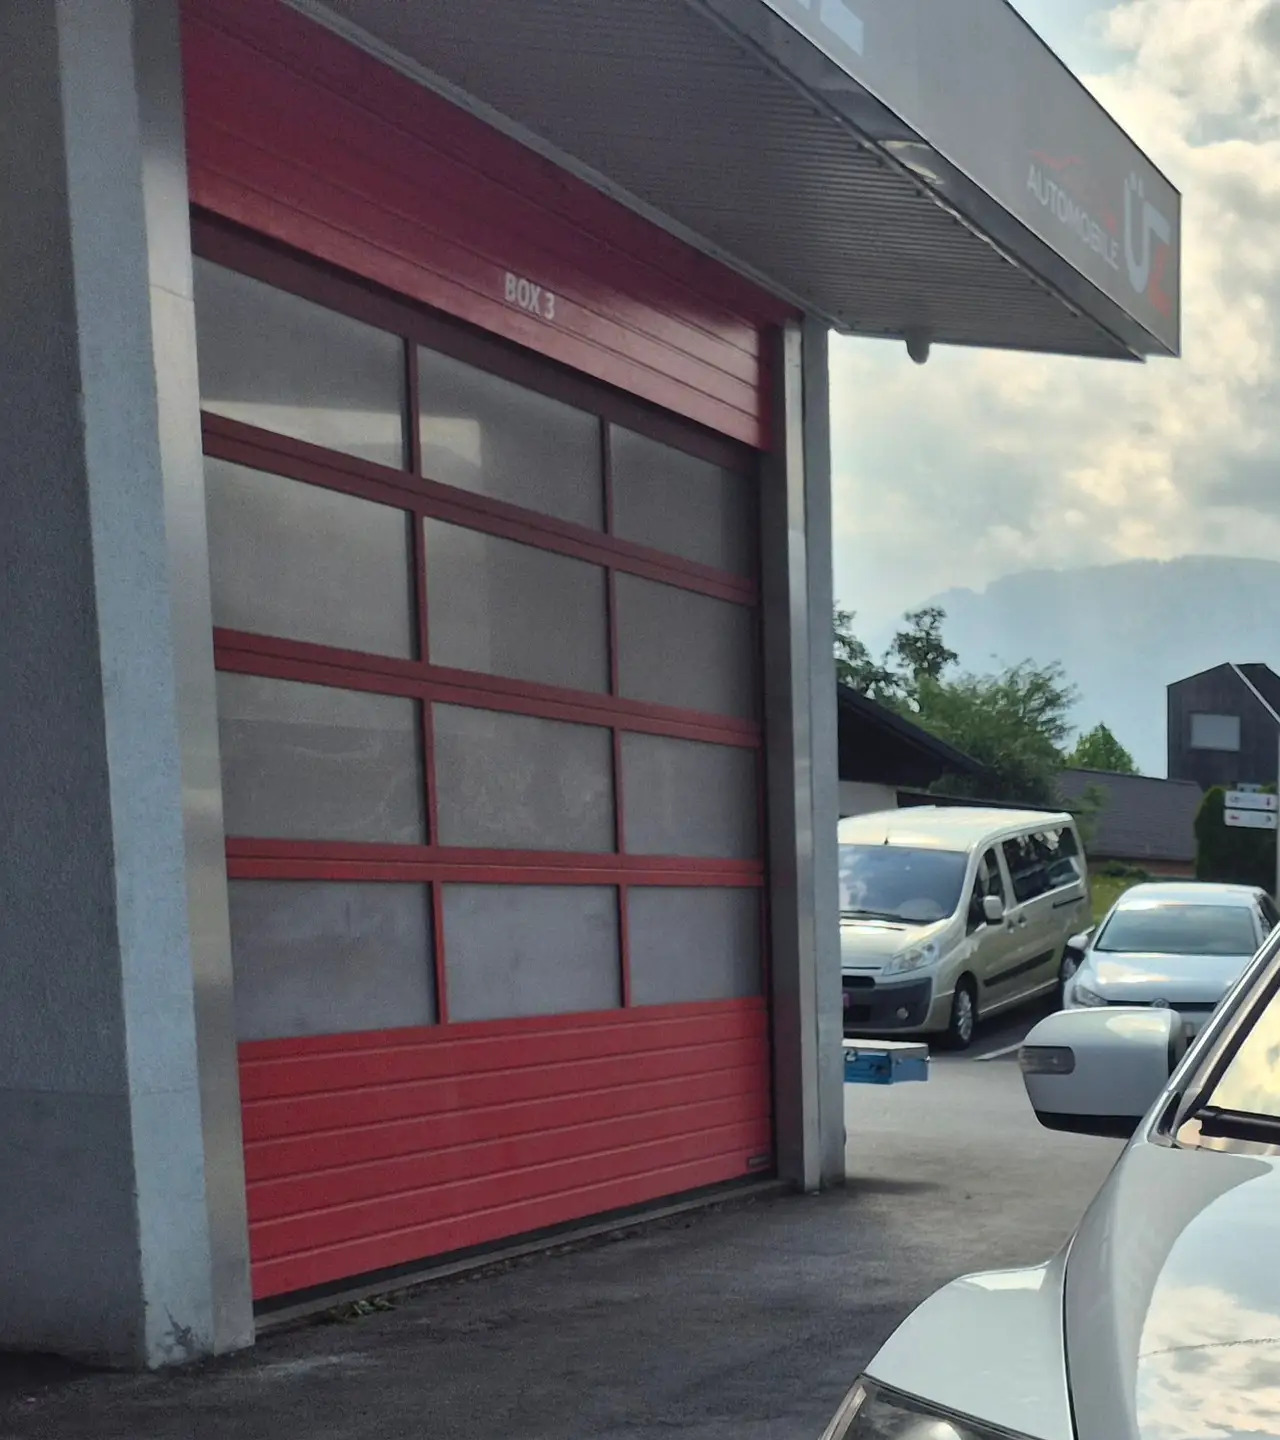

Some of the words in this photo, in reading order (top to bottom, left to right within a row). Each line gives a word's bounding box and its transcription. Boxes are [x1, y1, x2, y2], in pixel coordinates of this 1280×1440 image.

[1026, 163, 1119, 271] AUTOMOBILE
[504, 271, 541, 315] BOX
[543, 291, 555, 320] 3
